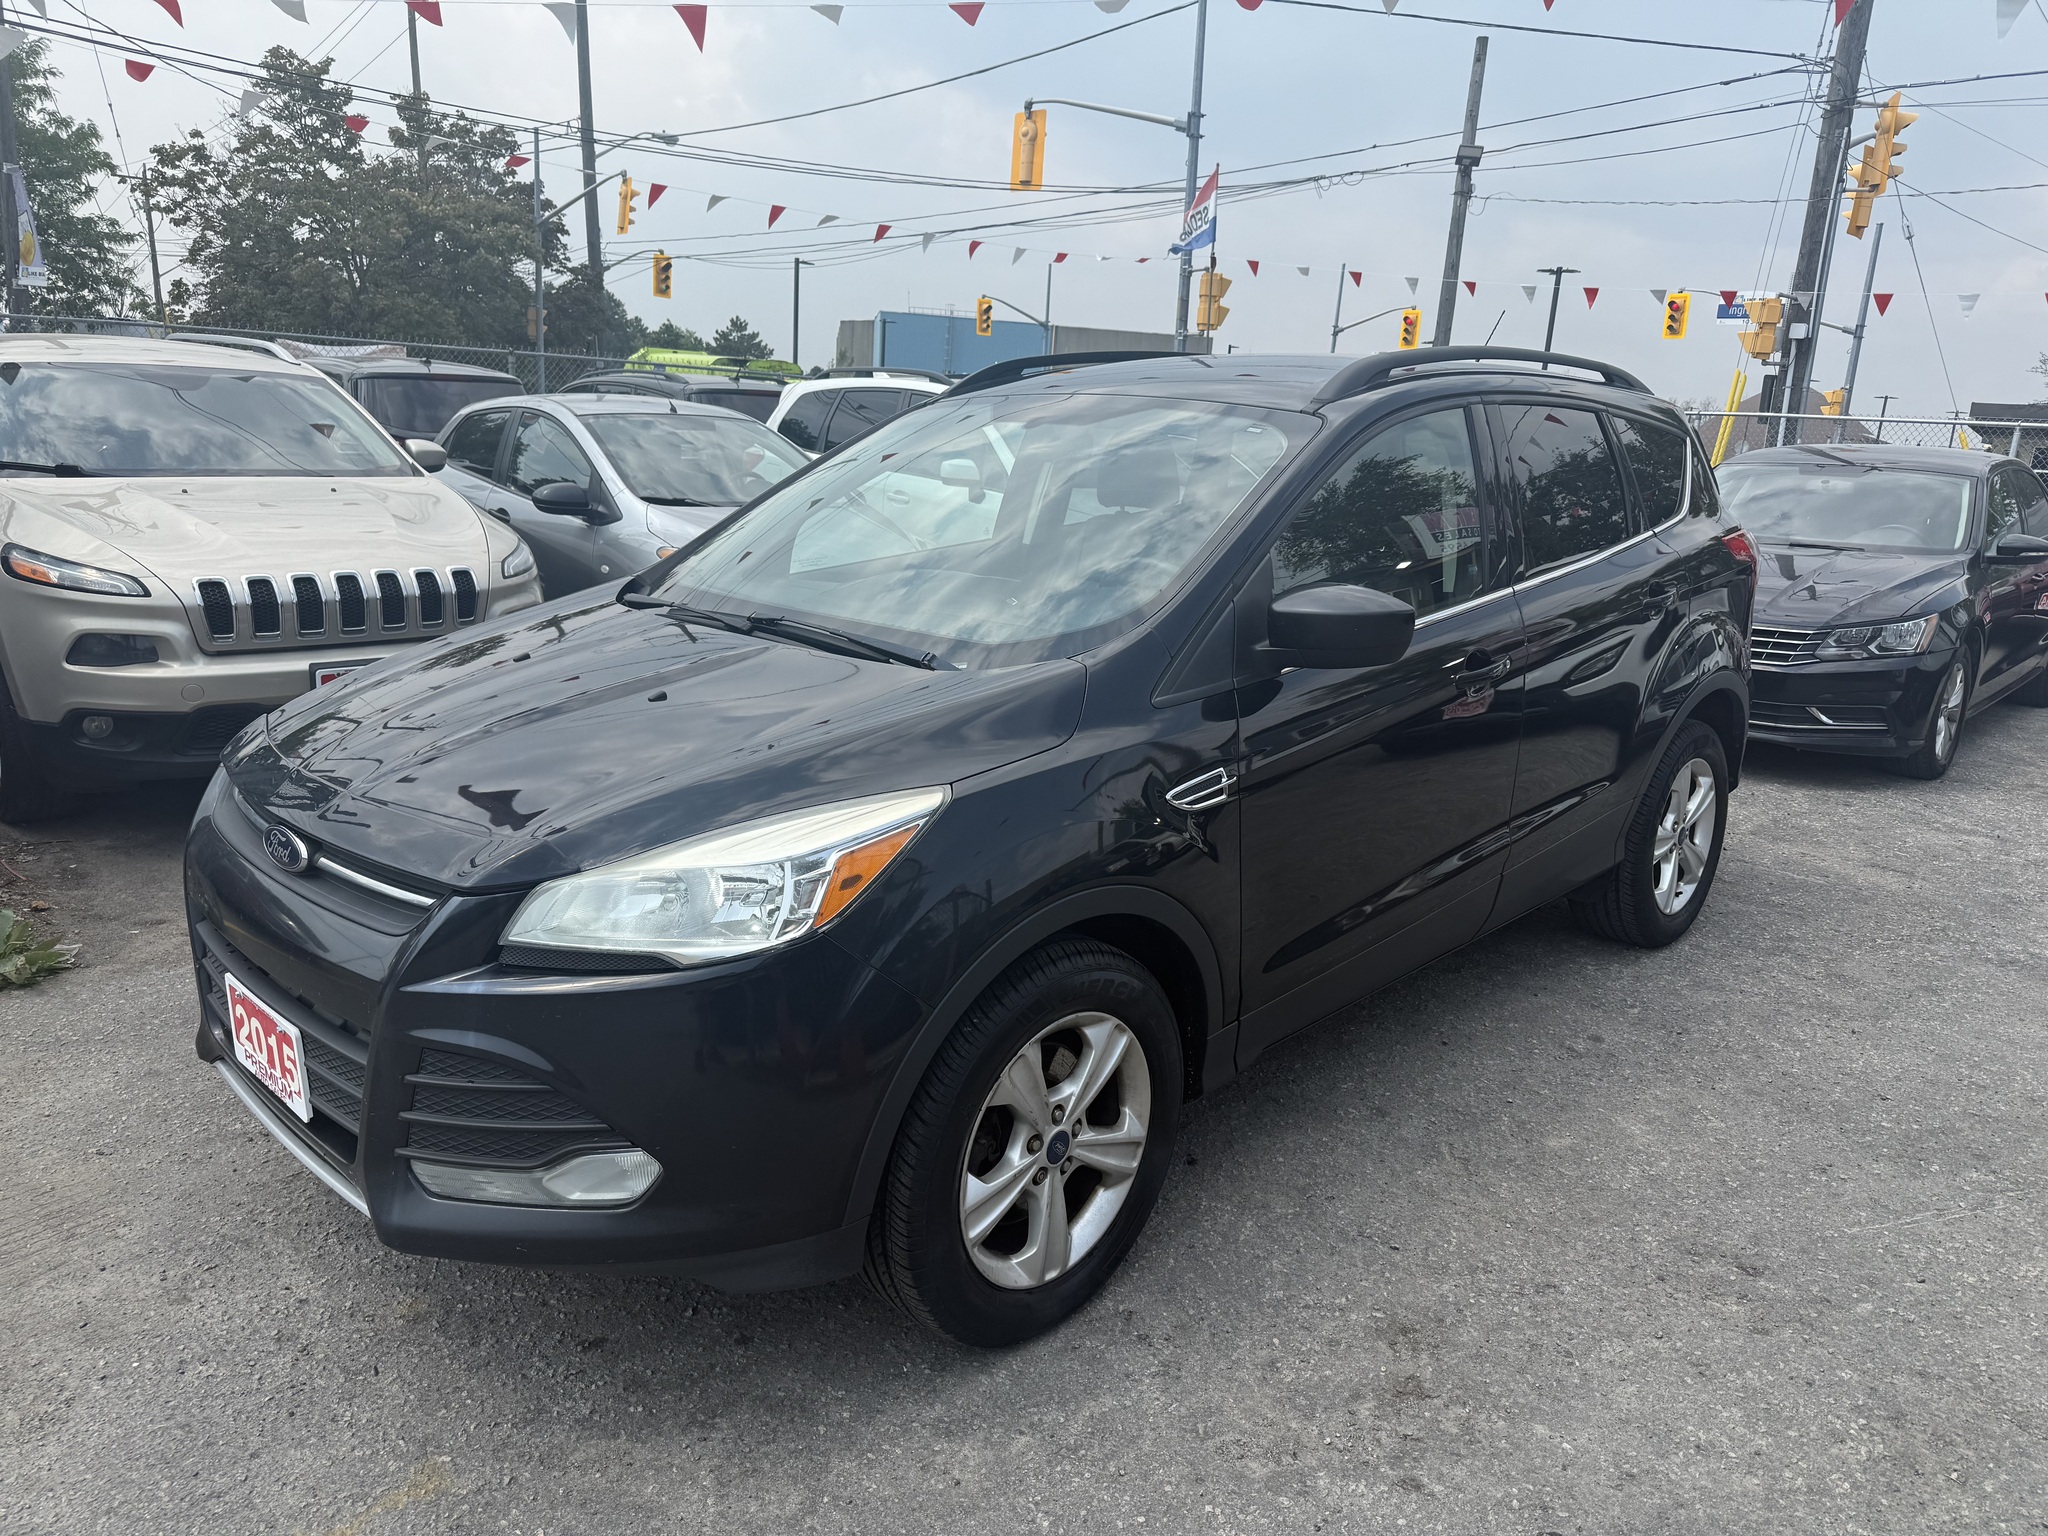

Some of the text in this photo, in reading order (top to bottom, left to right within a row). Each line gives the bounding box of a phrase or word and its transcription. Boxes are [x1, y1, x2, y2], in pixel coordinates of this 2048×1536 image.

[1729, 305, 1748, 317] Ingr
[267, 830, 292, 863] Ford
[235, 1003, 300, 1092] 2015
[244, 1048, 295, 1105] PREMIUM
